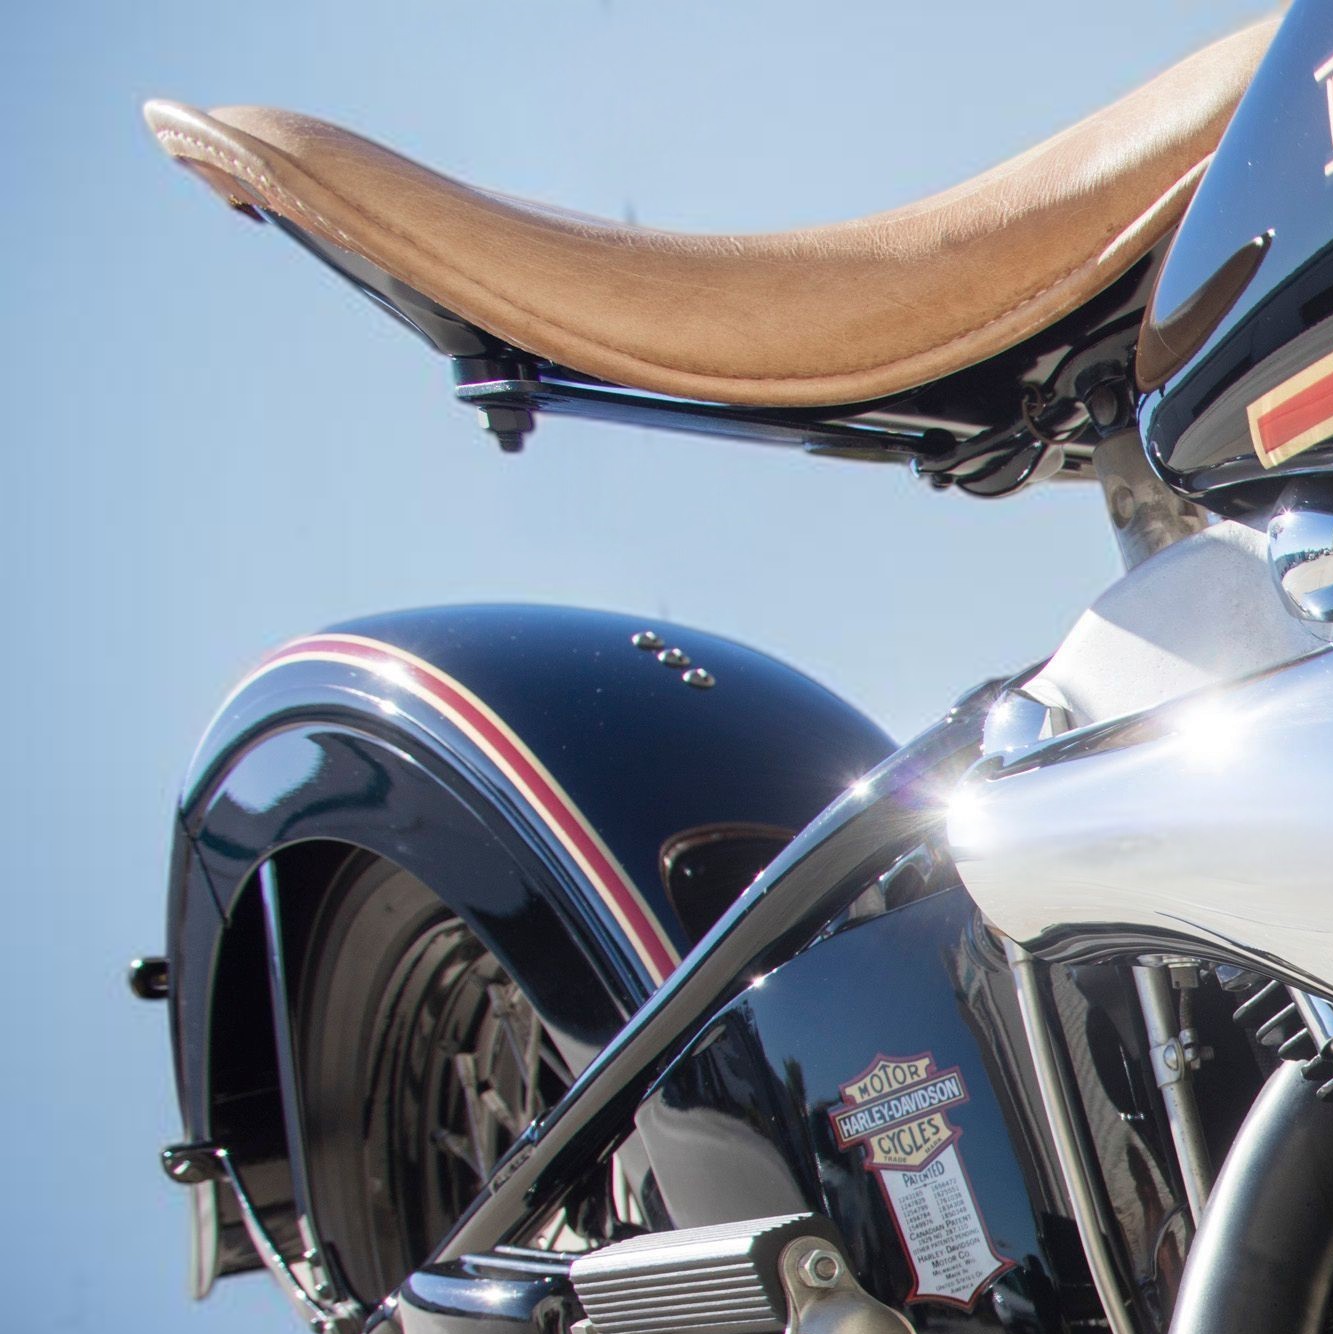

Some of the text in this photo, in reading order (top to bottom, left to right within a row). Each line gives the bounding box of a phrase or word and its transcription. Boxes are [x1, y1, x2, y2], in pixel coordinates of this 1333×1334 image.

[858, 1063, 920, 1098] MOTOR
[840, 1078, 959, 1137] HARLEY-DAVIDSON
[877, 1118, 940, 1157] CYCLES
[925, 1138, 942, 1153] MARK
[902, 1160, 945, 1187] PATENTED
[909, 1214, 971, 1241] CANADIAN PATENT
[931, 1236, 954, 1248] PATENTS
[932, 1255, 956, 1268] MOTOR
